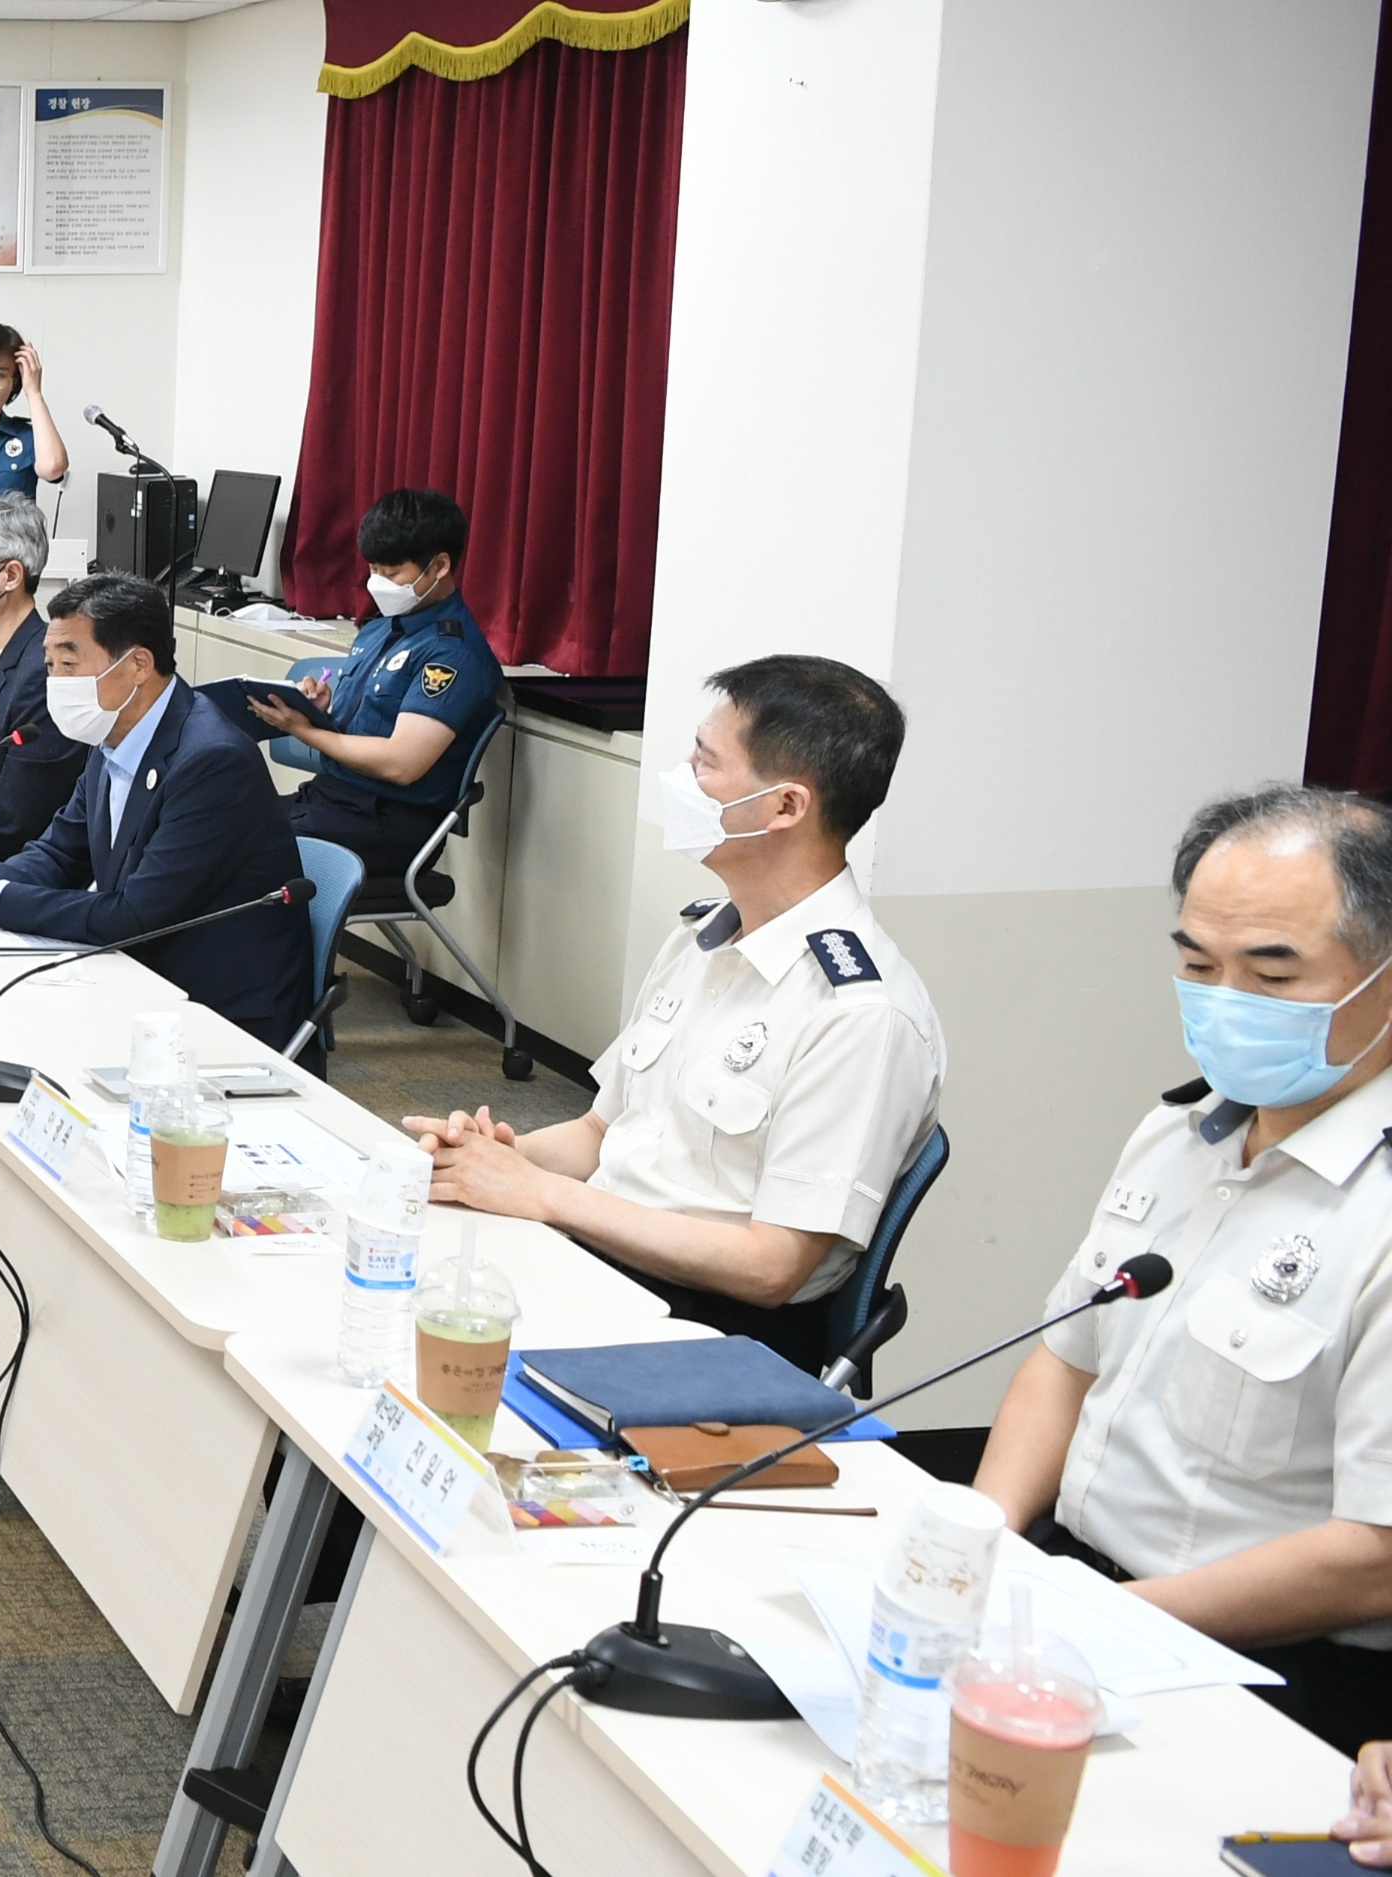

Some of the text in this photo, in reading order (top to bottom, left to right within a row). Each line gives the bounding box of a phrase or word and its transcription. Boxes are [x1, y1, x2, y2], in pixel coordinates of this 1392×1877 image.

[47, 97, 91, 111] 경찰 헌장
[367, 1255, 396, 1264] SAVE
[374, 1392, 406, 1432] 재난대응
[366, 1423, 386, 1452] 과장
[810, 1791, 866, 1855] 대응전략
[800, 1834, 834, 1876] 팀장
